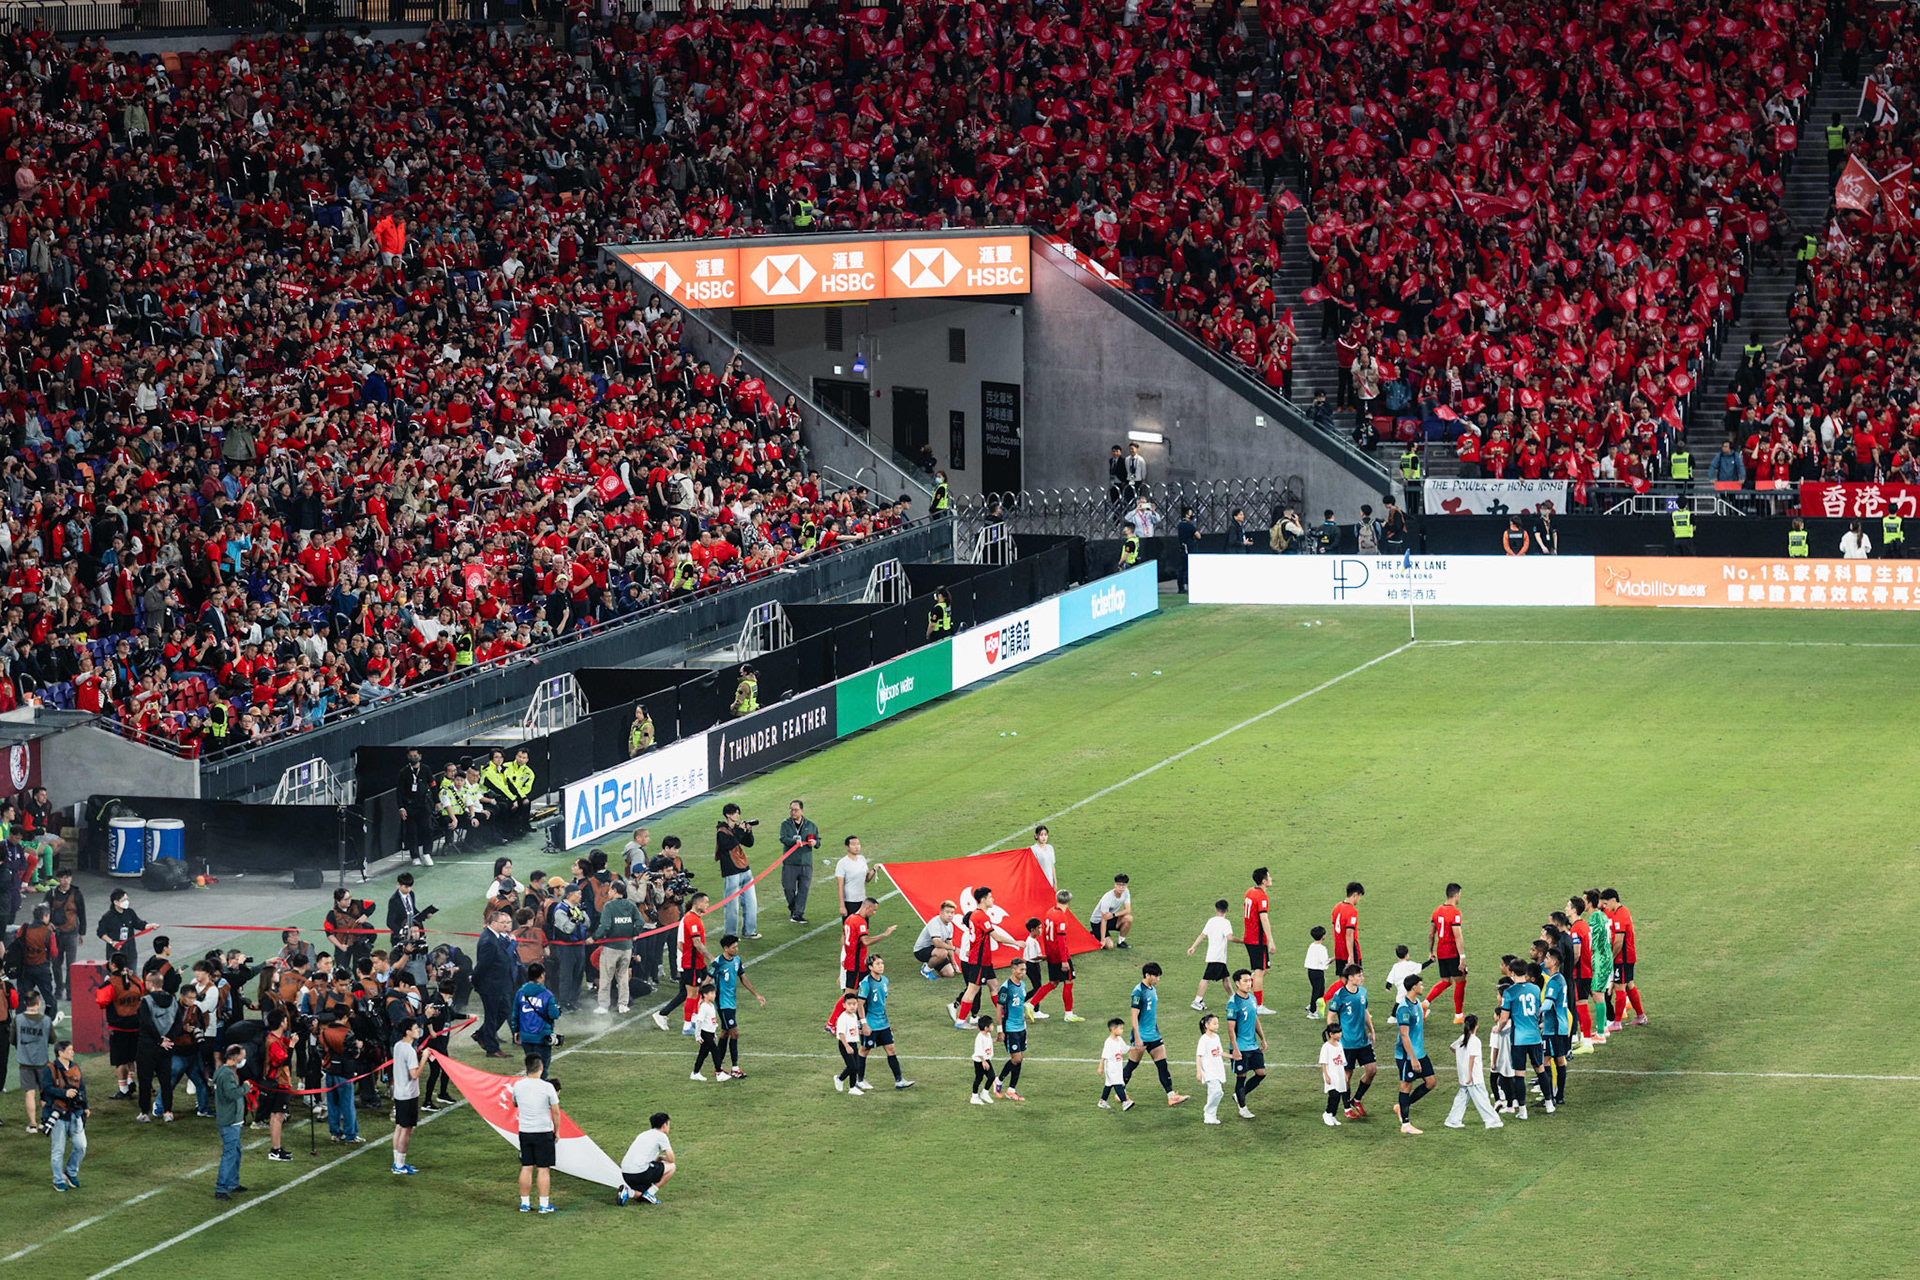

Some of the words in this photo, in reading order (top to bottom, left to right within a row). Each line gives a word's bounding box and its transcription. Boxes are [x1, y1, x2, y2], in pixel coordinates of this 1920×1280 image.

[821, 272, 876, 293] HSBC
[967, 266, 1025, 287] HSBC
[685, 279, 735, 300] HSBC
[985, 422, 995, 432] NW
[996, 422, 1010, 433] Pitch
[986, 433, 1000, 444] Pitch
[1001, 435, 1020, 446] Access
[986, 445, 1011, 459] Vomitory
[1432, 480, 1448, 490] THE
[1452, 480, 1487, 491] POWER
[1507, 481, 1534, 491] HONG
[1538, 481, 1564, 491] KONG
[1376, 561, 1392, 570] THE
[1396, 561, 1420, 570] PRK
[1424, 561, 1447, 570] LANE
[1615, 580, 1678, 597] Mobility
[1001, 619, 1030, 661] 日清食品
[728, 725, 778, 762] THUNDER
[782, 705, 828, 742] FEATHER
[614, 916, 633, 924] HKFA
[1334, 912, 1342, 934] 6
[1437, 915, 1445, 938] 7
[1011, 997, 1021, 1007] 20
[1518, 992, 1536, 1017] 13
[1346, 1005, 1353, 1015] 3
[20, 1027, 44, 1036] HKFA
